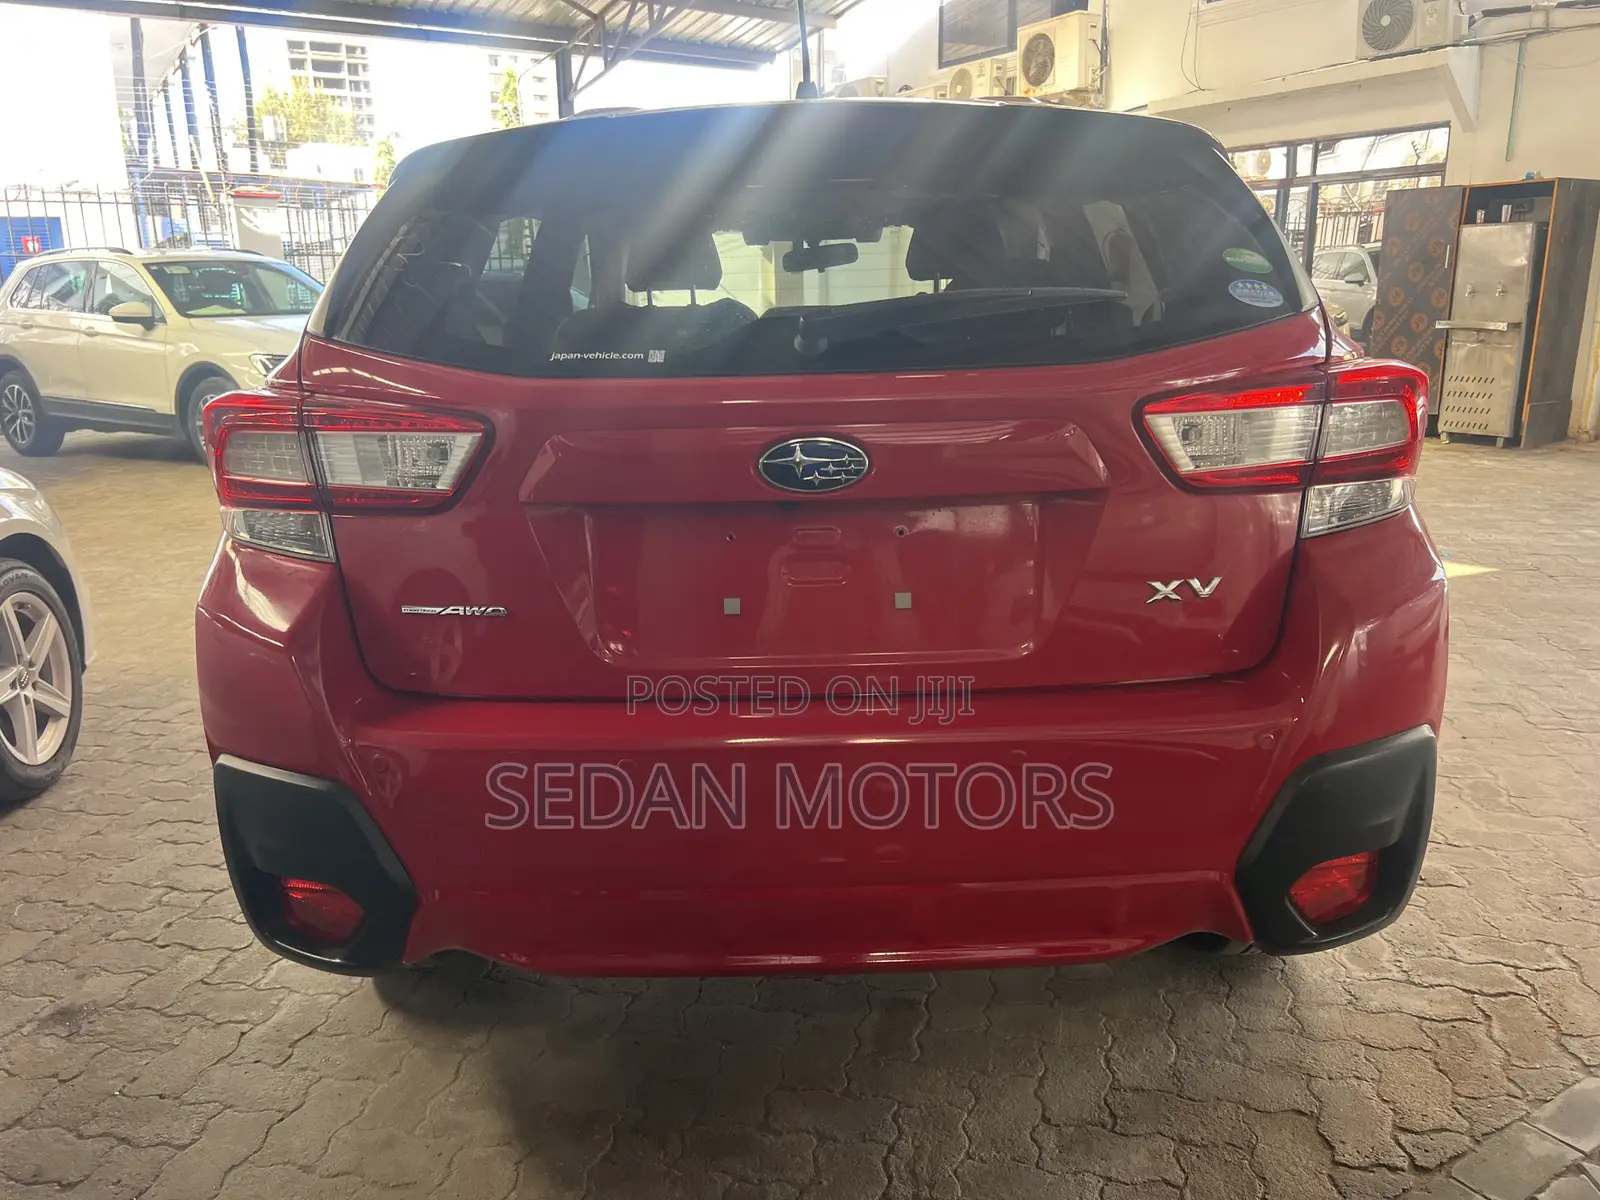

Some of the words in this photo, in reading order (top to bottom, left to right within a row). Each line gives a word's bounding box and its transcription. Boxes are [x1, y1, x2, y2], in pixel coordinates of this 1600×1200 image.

[549, 351, 644, 361] japan-vehicle.com
[1146, 576, 1223, 604] XV
[440, 605, 507, 616] AWD
